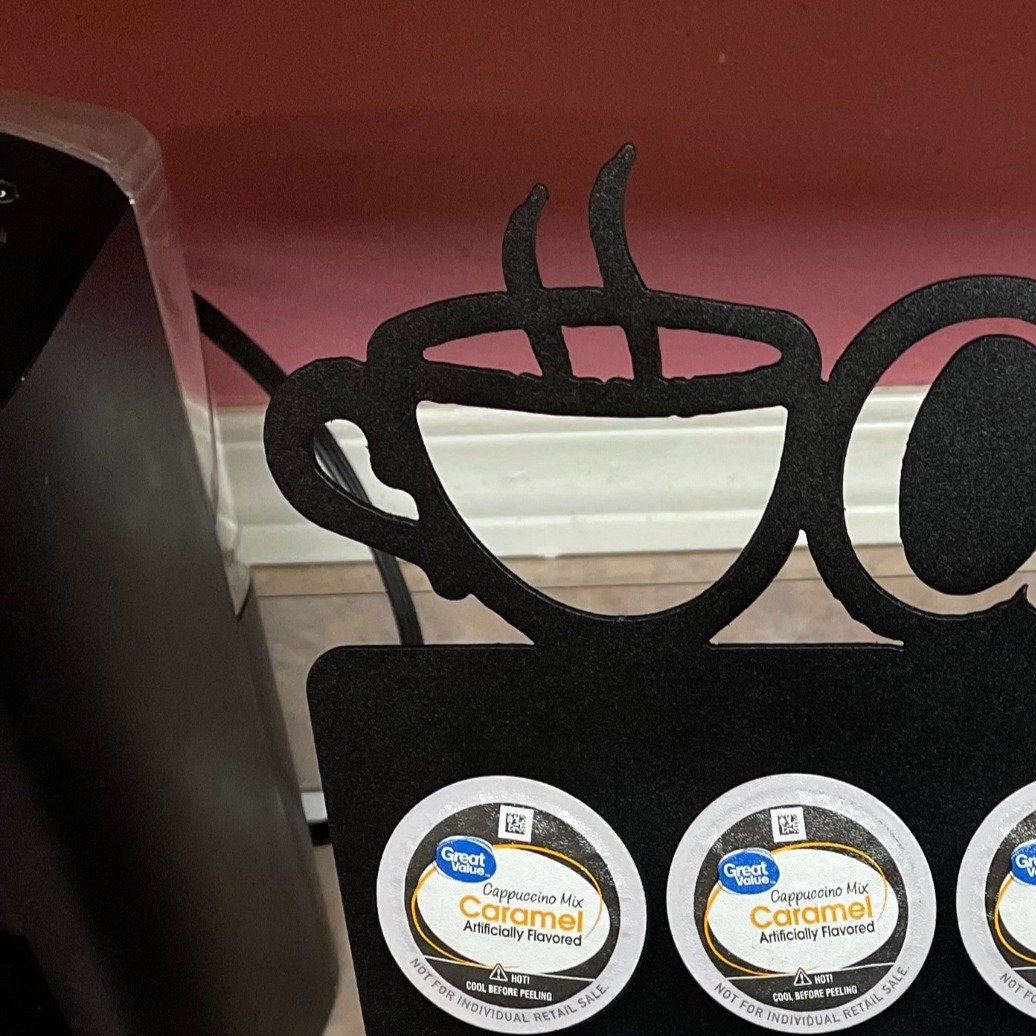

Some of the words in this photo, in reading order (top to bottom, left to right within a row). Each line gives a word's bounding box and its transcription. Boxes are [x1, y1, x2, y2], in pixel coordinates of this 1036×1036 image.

[441, 847, 485, 867] Great
[451, 862, 484, 875] Value
[723, 861, 768, 879] Great
[735, 876, 769, 886] Value
[483, 882, 556, 905] Cappuccino
[560, 893, 584, 908] Mix
[771, 886, 843, 907] Cappuccino
[847, 881, 869, 895] Mix
[459, 895, 583, 932] Caramel
[750, 895, 873, 929] Caramel
[463, 920, 524, 941] Artificially
[527, 929, 582, 946] Flavored
[759, 927, 818, 943] Artificially
[821, 920, 875, 938] Flavored
[714, 982, 736, 1003] NOT
[739, 999, 764, 1018] FOR
[767, 1010, 841, 1026] INDIVIDUAL
[841, 993, 883, 1018] RETAIL
[772, 991, 794, 1002] COOL
[794, 988, 824, 1000] BEFORE
[825, 985, 858, 997] PEELING
